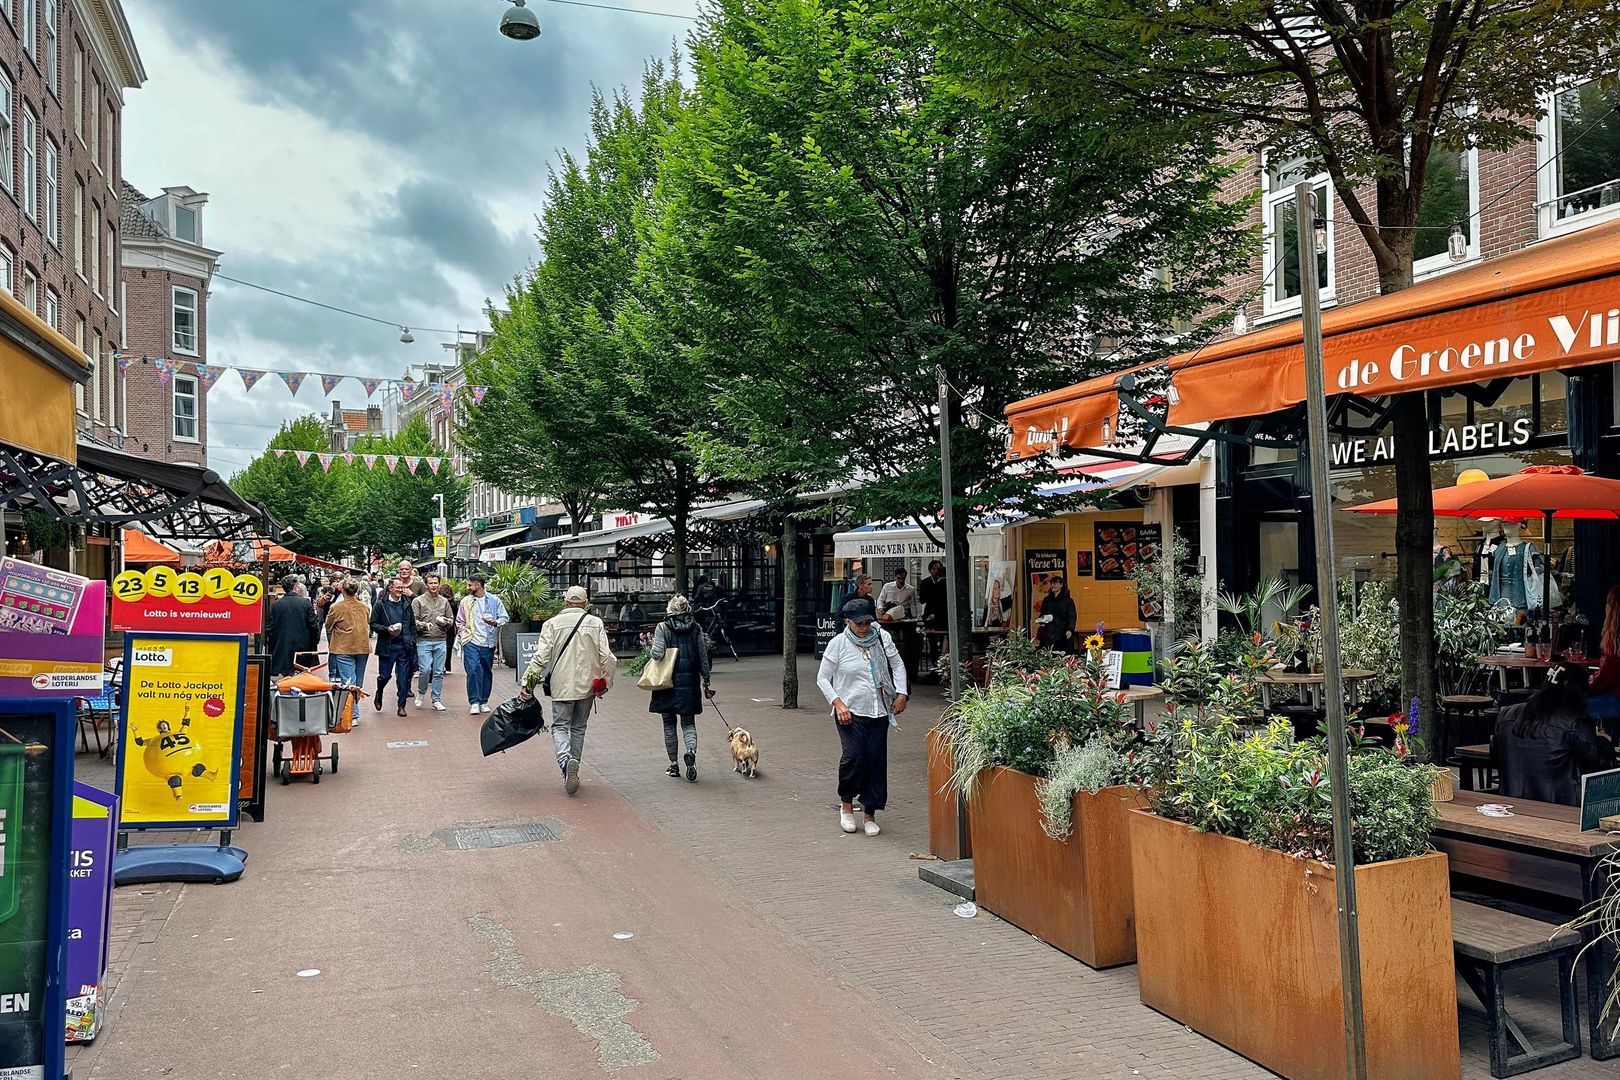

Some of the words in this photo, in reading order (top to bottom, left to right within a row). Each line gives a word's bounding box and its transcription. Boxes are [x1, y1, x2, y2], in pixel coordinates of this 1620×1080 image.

[1336, 359, 1379, 389] de
[1389, 332, 1536, 380] Groene
[1428, 417, 1531, 455] LABELS
[1332, 441, 1366, 465] WE
[860, 544, 886, 555] HARING
[886, 543, 906, 555] VERS
[907, 542, 924, 554] VAN
[117, 577, 143, 594] 23
[153, 573, 167, 588] 5
[178, 580, 200, 594] 13
[233, 581, 258, 597] 40
[143, 609, 168, 618] Lotto
[170, 610, 178, 618] is
[180, 610, 231, 619] vernieuwd!
[135, 652, 167, 662] Lotto.
[157, 681, 182, 689] Lotto
[184, 682, 223, 691] Jackpot
[173, 691, 193, 701] nóg
[195, 692, 225, 700] vaker!
[160, 733, 190, 750] 45
